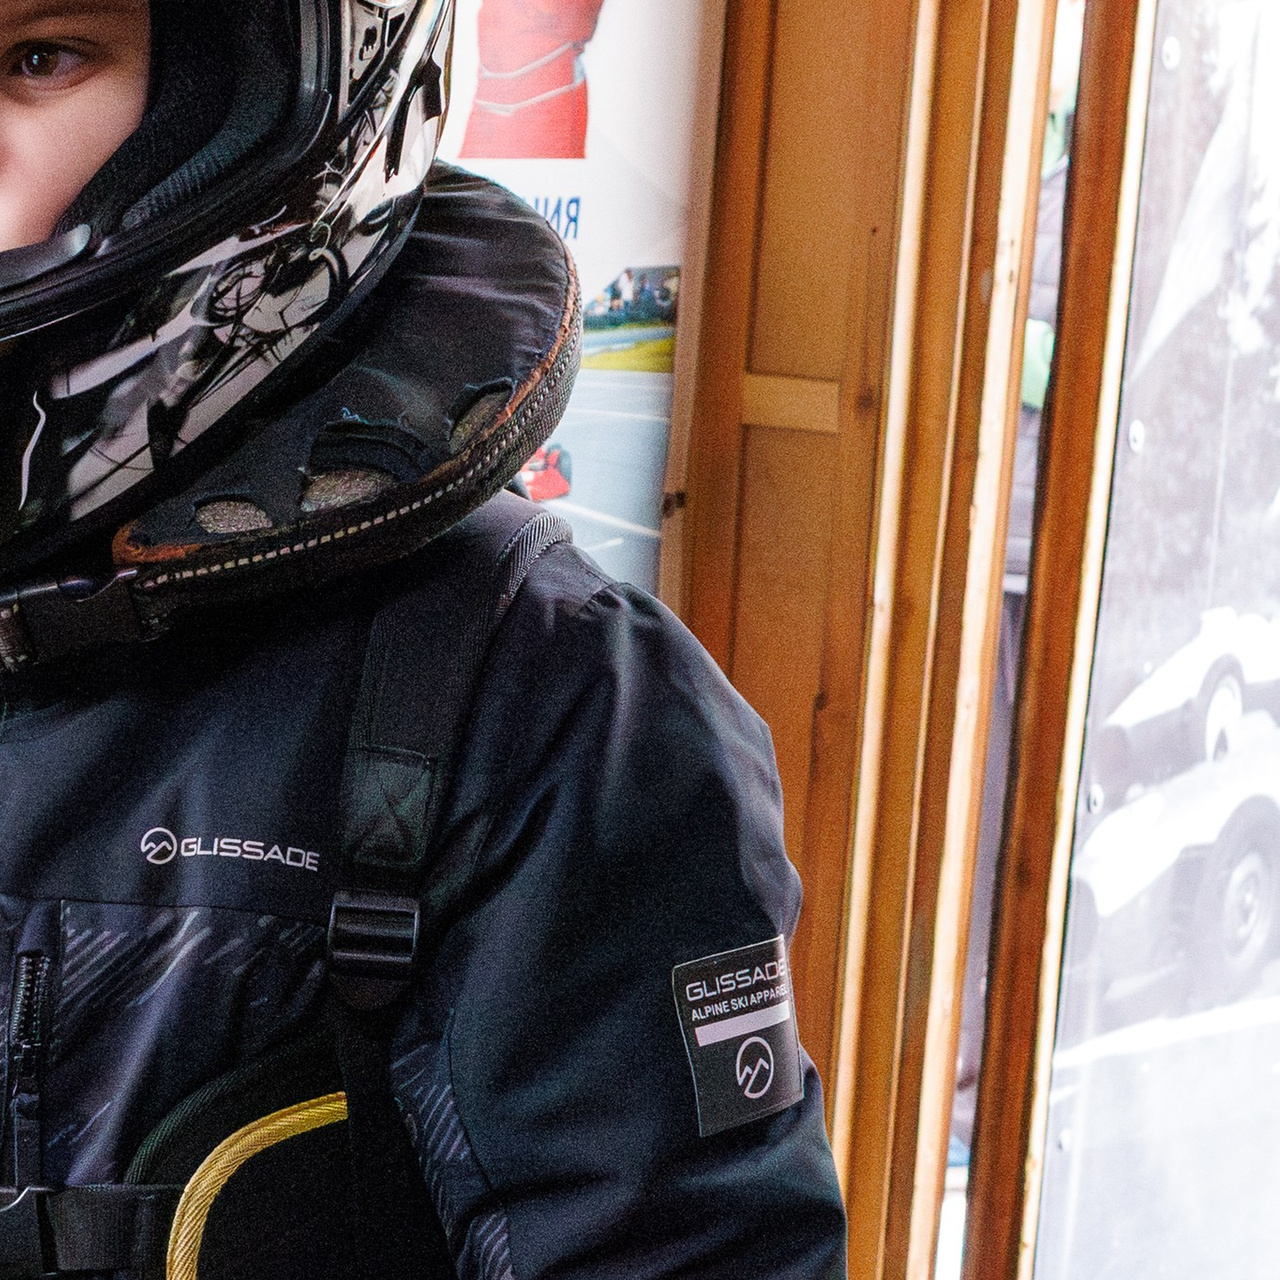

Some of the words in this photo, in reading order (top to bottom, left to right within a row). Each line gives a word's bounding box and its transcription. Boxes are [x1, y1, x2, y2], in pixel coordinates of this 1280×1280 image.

[180, 837, 320, 871] GLISSADE
[685, 959, 786, 1002] GLISSADE
[691, 1001, 731, 1022] ALPINE
[731, 993, 750, 1011] SKI
